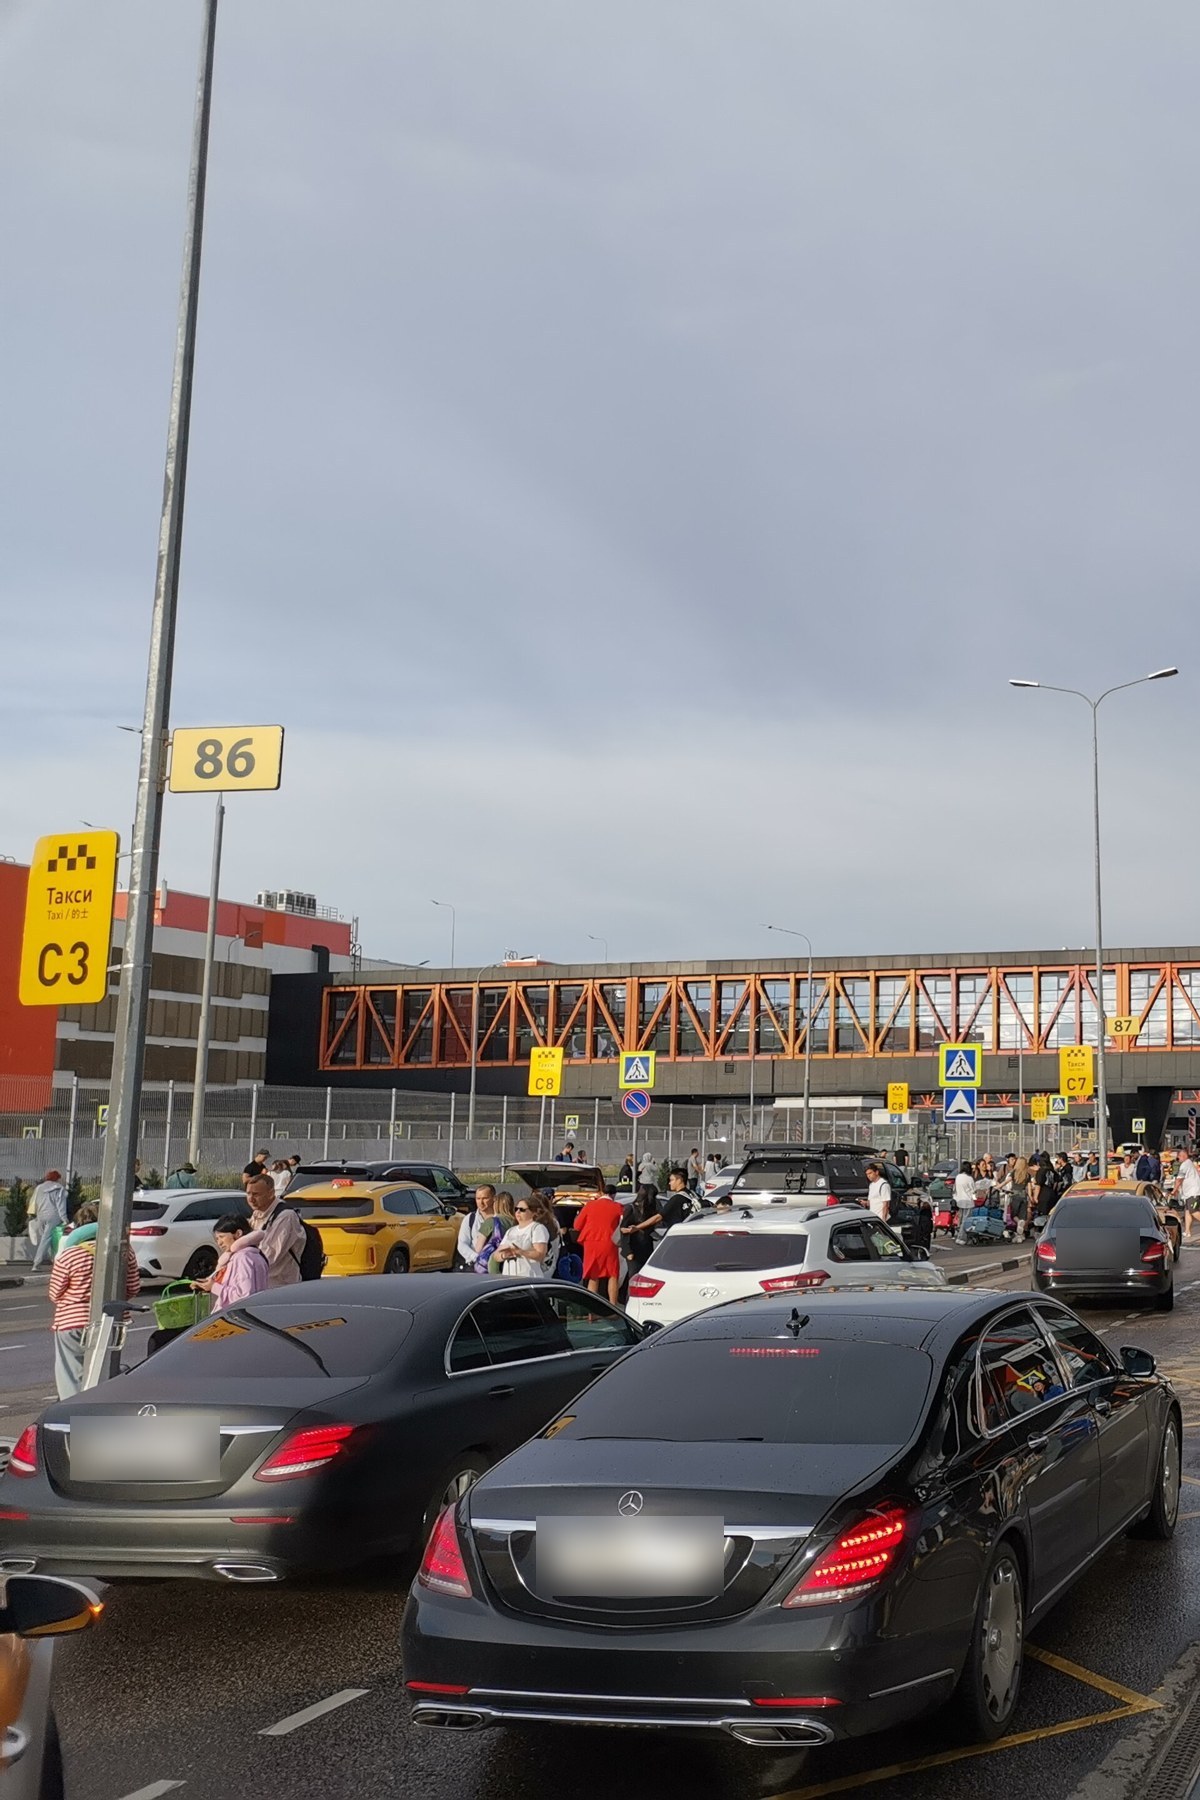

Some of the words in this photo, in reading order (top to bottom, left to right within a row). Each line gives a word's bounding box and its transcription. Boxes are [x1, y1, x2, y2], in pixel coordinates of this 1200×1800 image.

[194, 738, 255, 779] 86
[47, 887, 92, 905] Такси
[47, 910, 63, 920] Taxi
[71, 908, 88, 919] 的士
[38, 941, 90, 987] C3
[1114, 1020, 1132, 1032] 87
[535, 1078, 554, 1090] C8
[1067, 1078, 1086, 1090] C7
[892, 1102, 904, 1110] C8
